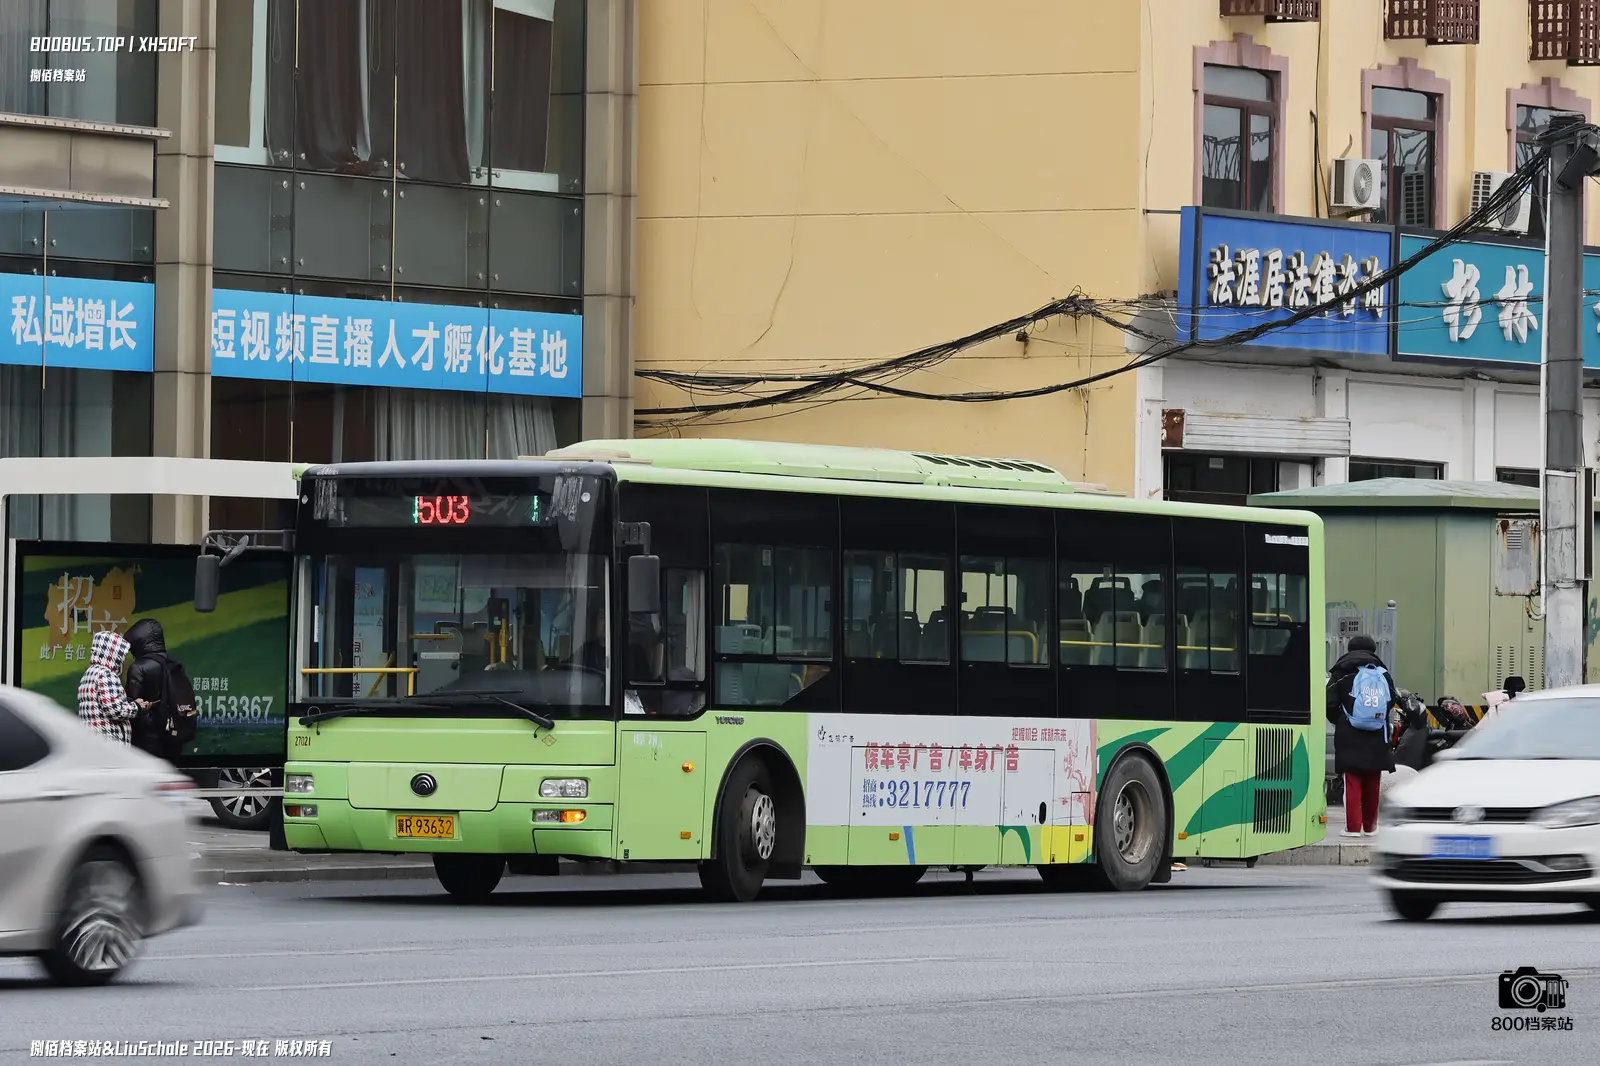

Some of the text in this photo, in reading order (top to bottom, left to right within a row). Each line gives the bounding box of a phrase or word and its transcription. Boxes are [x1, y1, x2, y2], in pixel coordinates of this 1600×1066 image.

[11, 295, 137, 351] 私域增长
[211, 308, 568, 379] 短视频直播人才孵化基地
[417, 495, 469, 524] 503
[193, 677, 228, 691] 招商热线
[1364, 695, 1379, 707] 23
